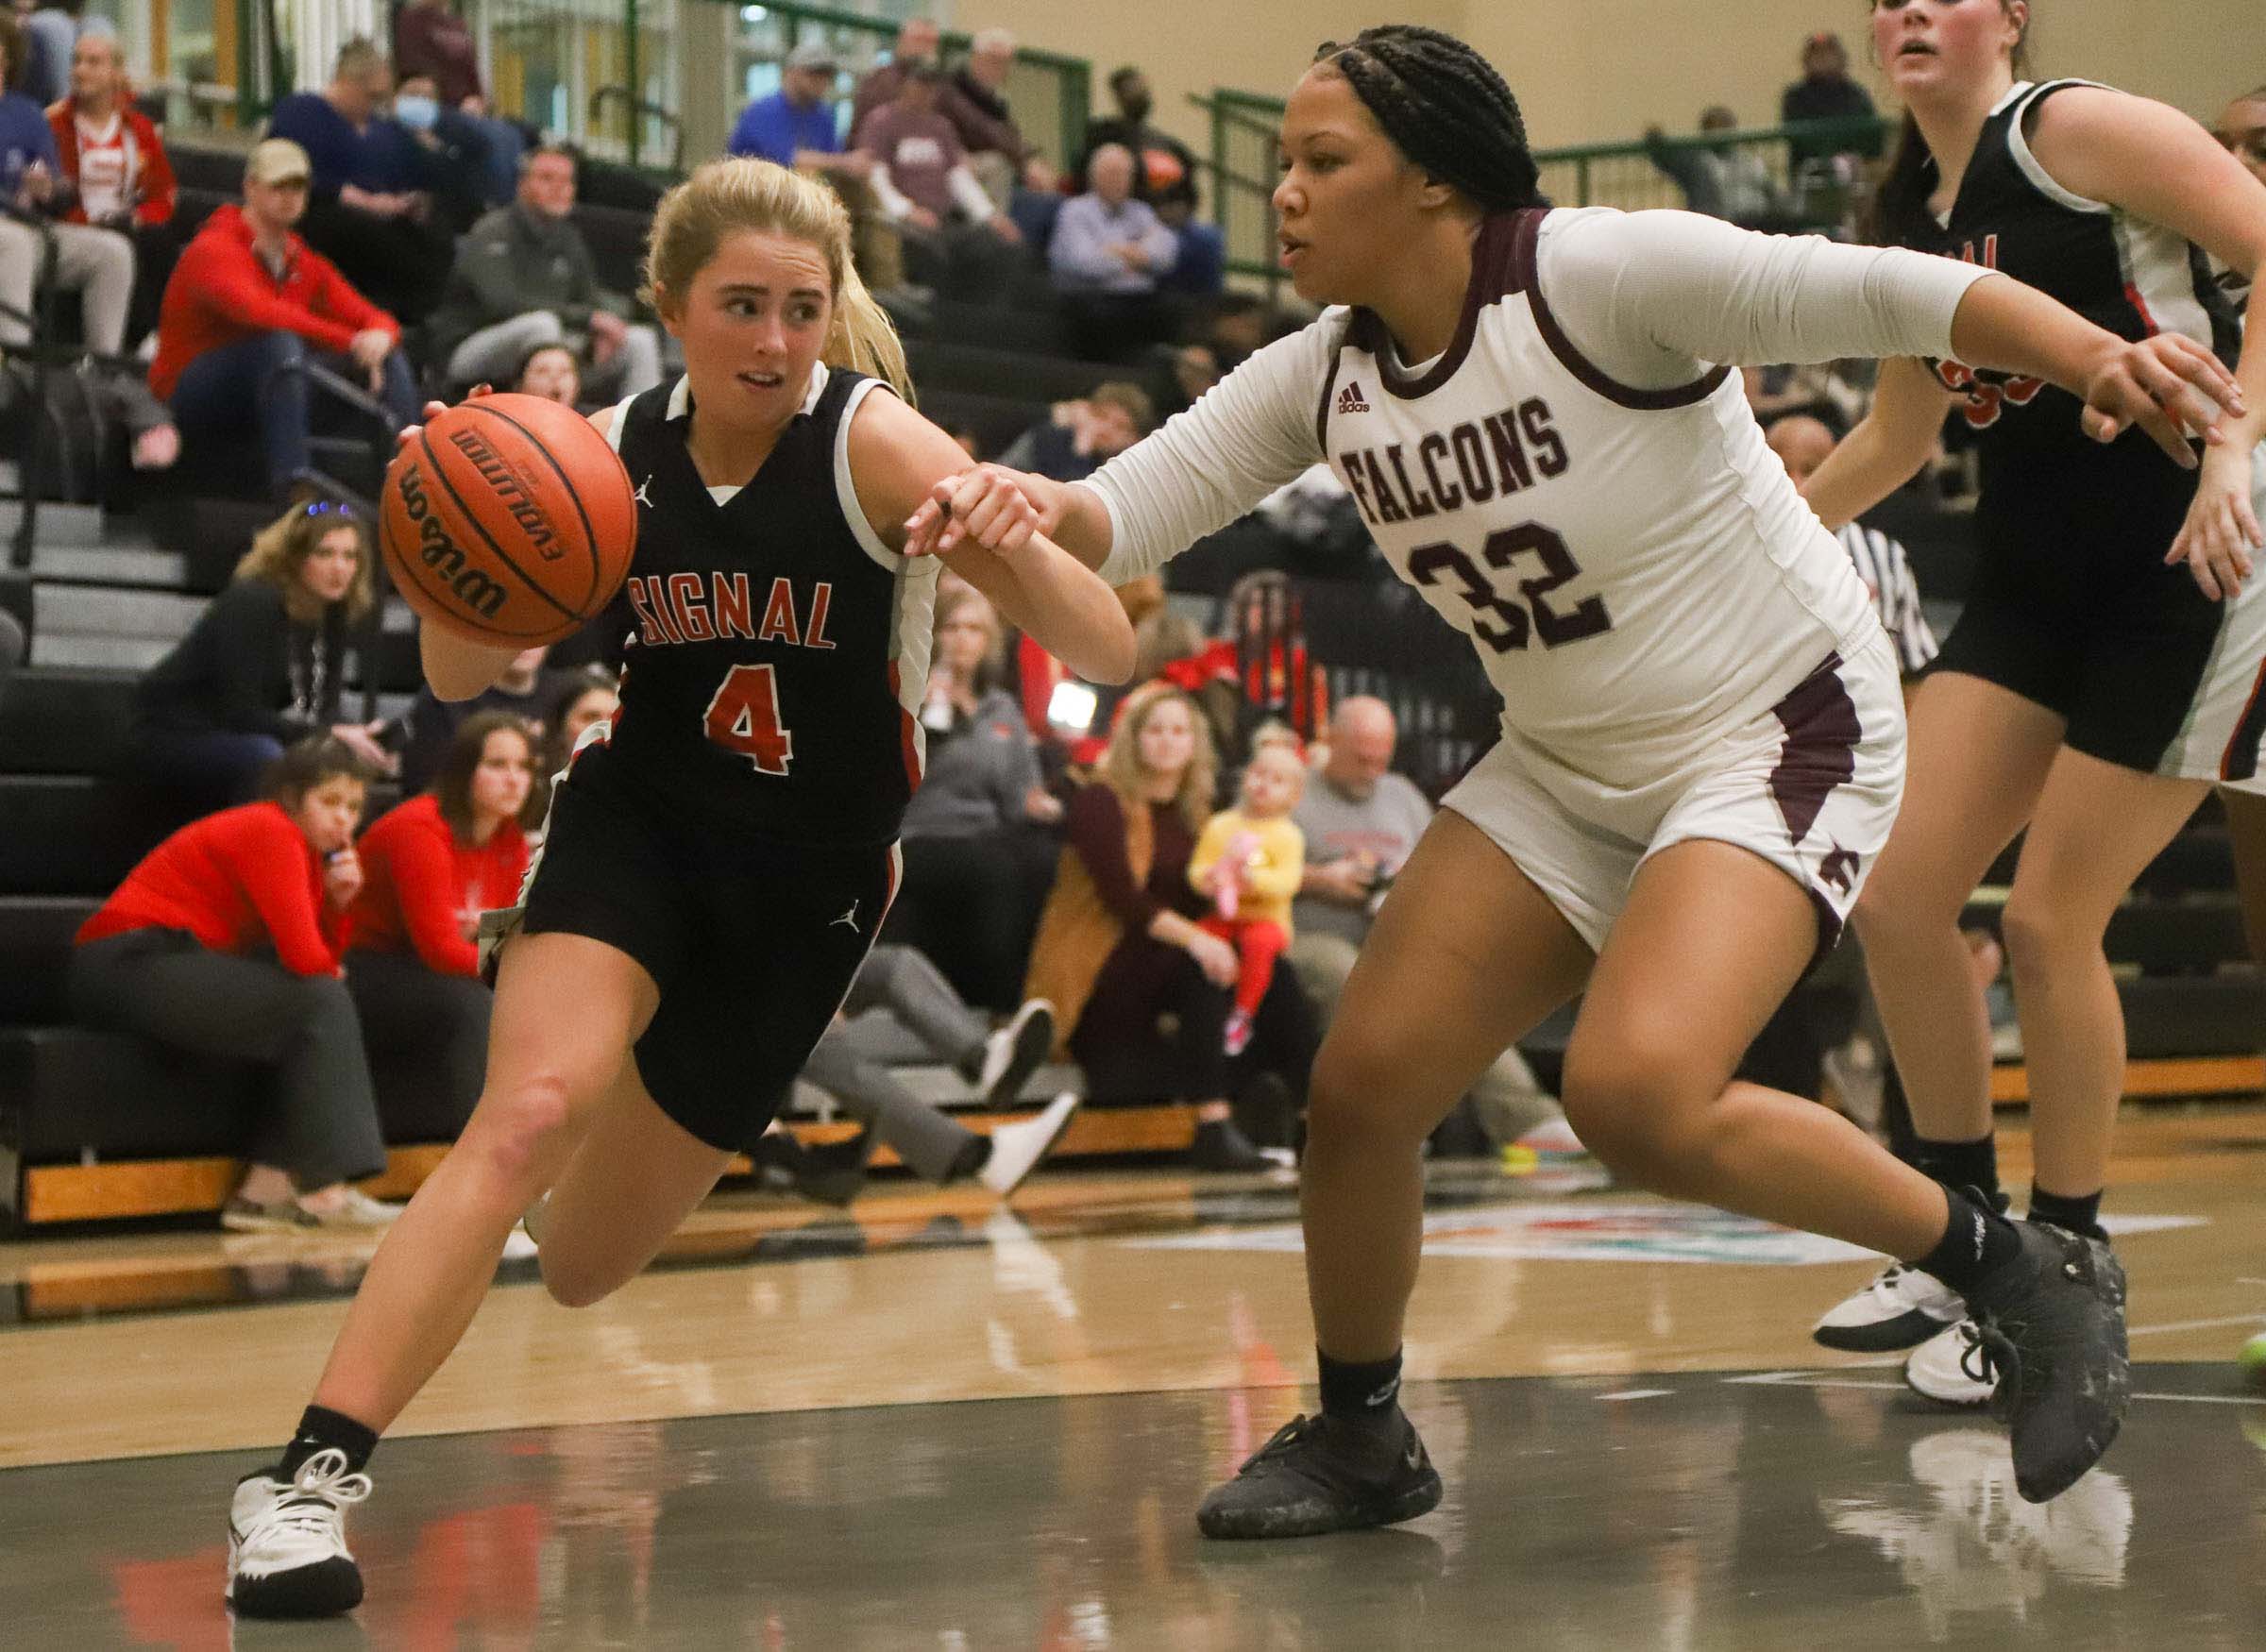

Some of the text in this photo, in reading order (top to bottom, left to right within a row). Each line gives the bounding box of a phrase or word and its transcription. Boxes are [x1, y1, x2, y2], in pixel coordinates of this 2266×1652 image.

[448, 428, 565, 563] EVOLUTION
[1340, 396, 1571, 525] FALCONS
[399, 462, 509, 619] Wilson
[1406, 519, 1614, 654] 32
[627, 571, 837, 650] SIGNAL
[702, 664, 793, 776] 4
